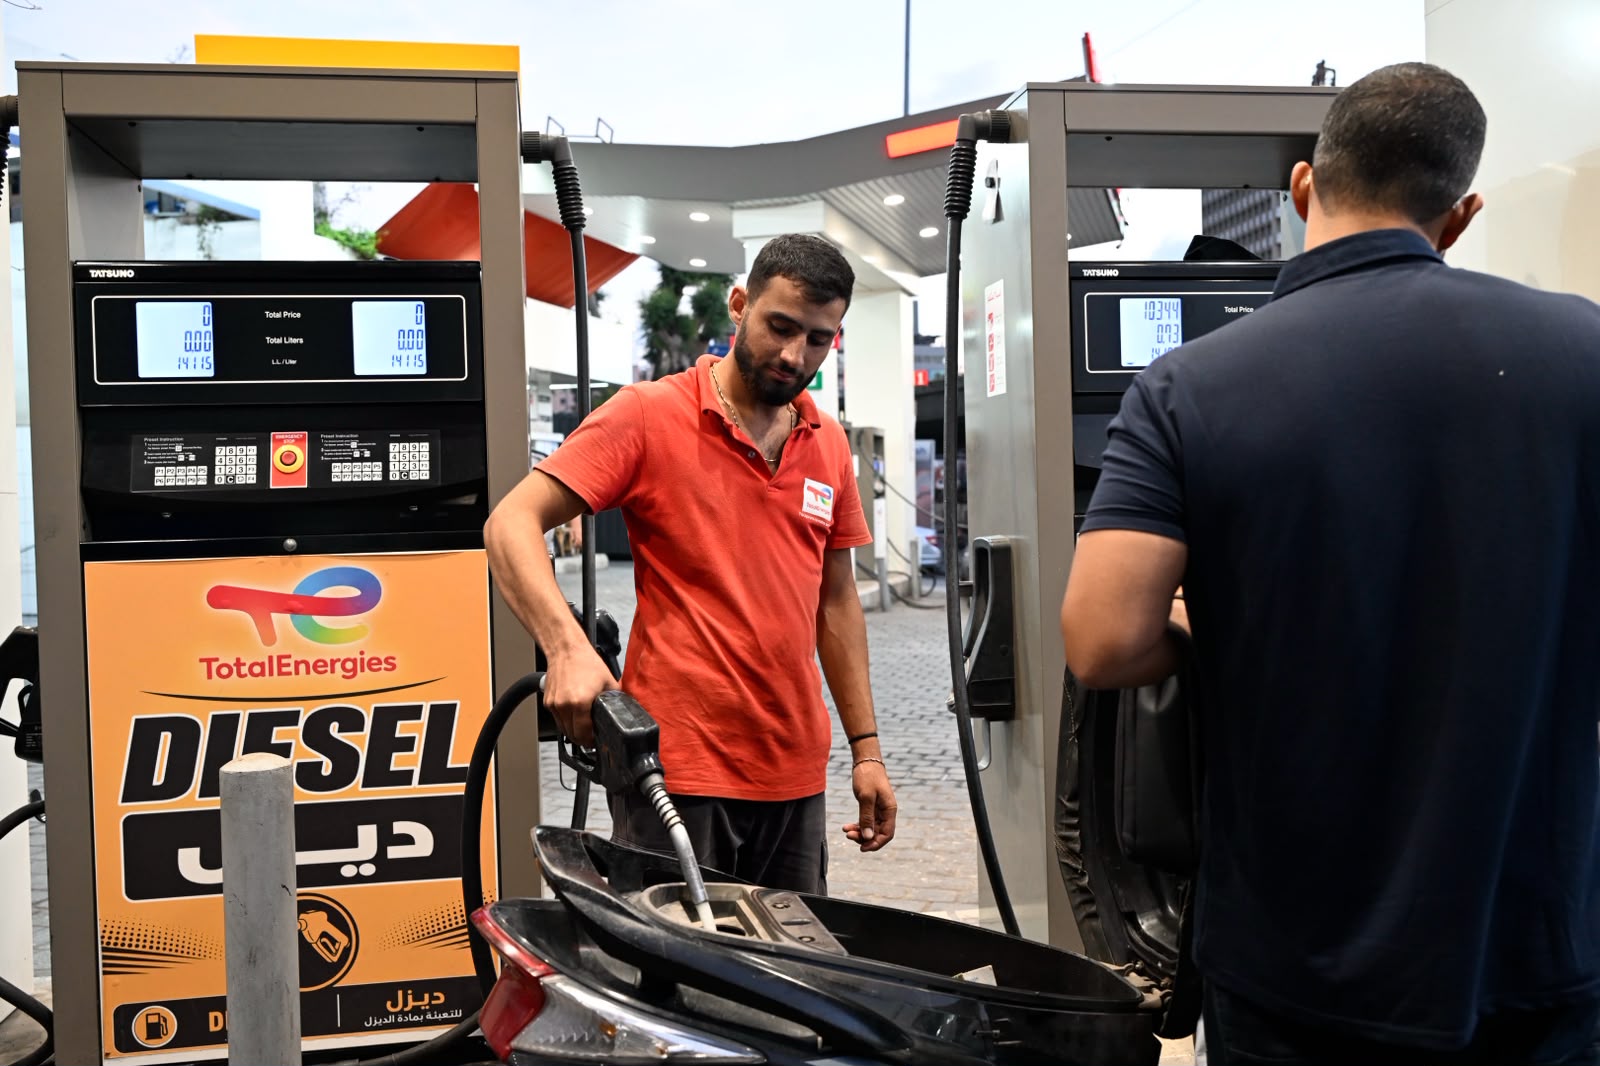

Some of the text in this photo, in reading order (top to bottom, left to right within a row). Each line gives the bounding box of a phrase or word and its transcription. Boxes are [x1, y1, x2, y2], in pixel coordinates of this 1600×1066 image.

[89, 269, 134, 278] TATSUNO
[203, 304, 210, 326] 0
[416, 304, 423, 325] 0
[1144, 301, 1179, 320] 10344
[184, 330, 212, 352] 0.00
[398, 329, 424, 351] 0.00
[1157, 324, 1179, 344] 0.73
[178, 356, 212, 370] 14115
[392, 354, 424, 367] 14115
[199, 650, 397, 680] TotalEnergies
[119, 701, 469, 805] DIESEL
[386, 989, 446, 1012] ديزل
[364, 1008, 462, 1027] للتعبئة بمادة الديزل
